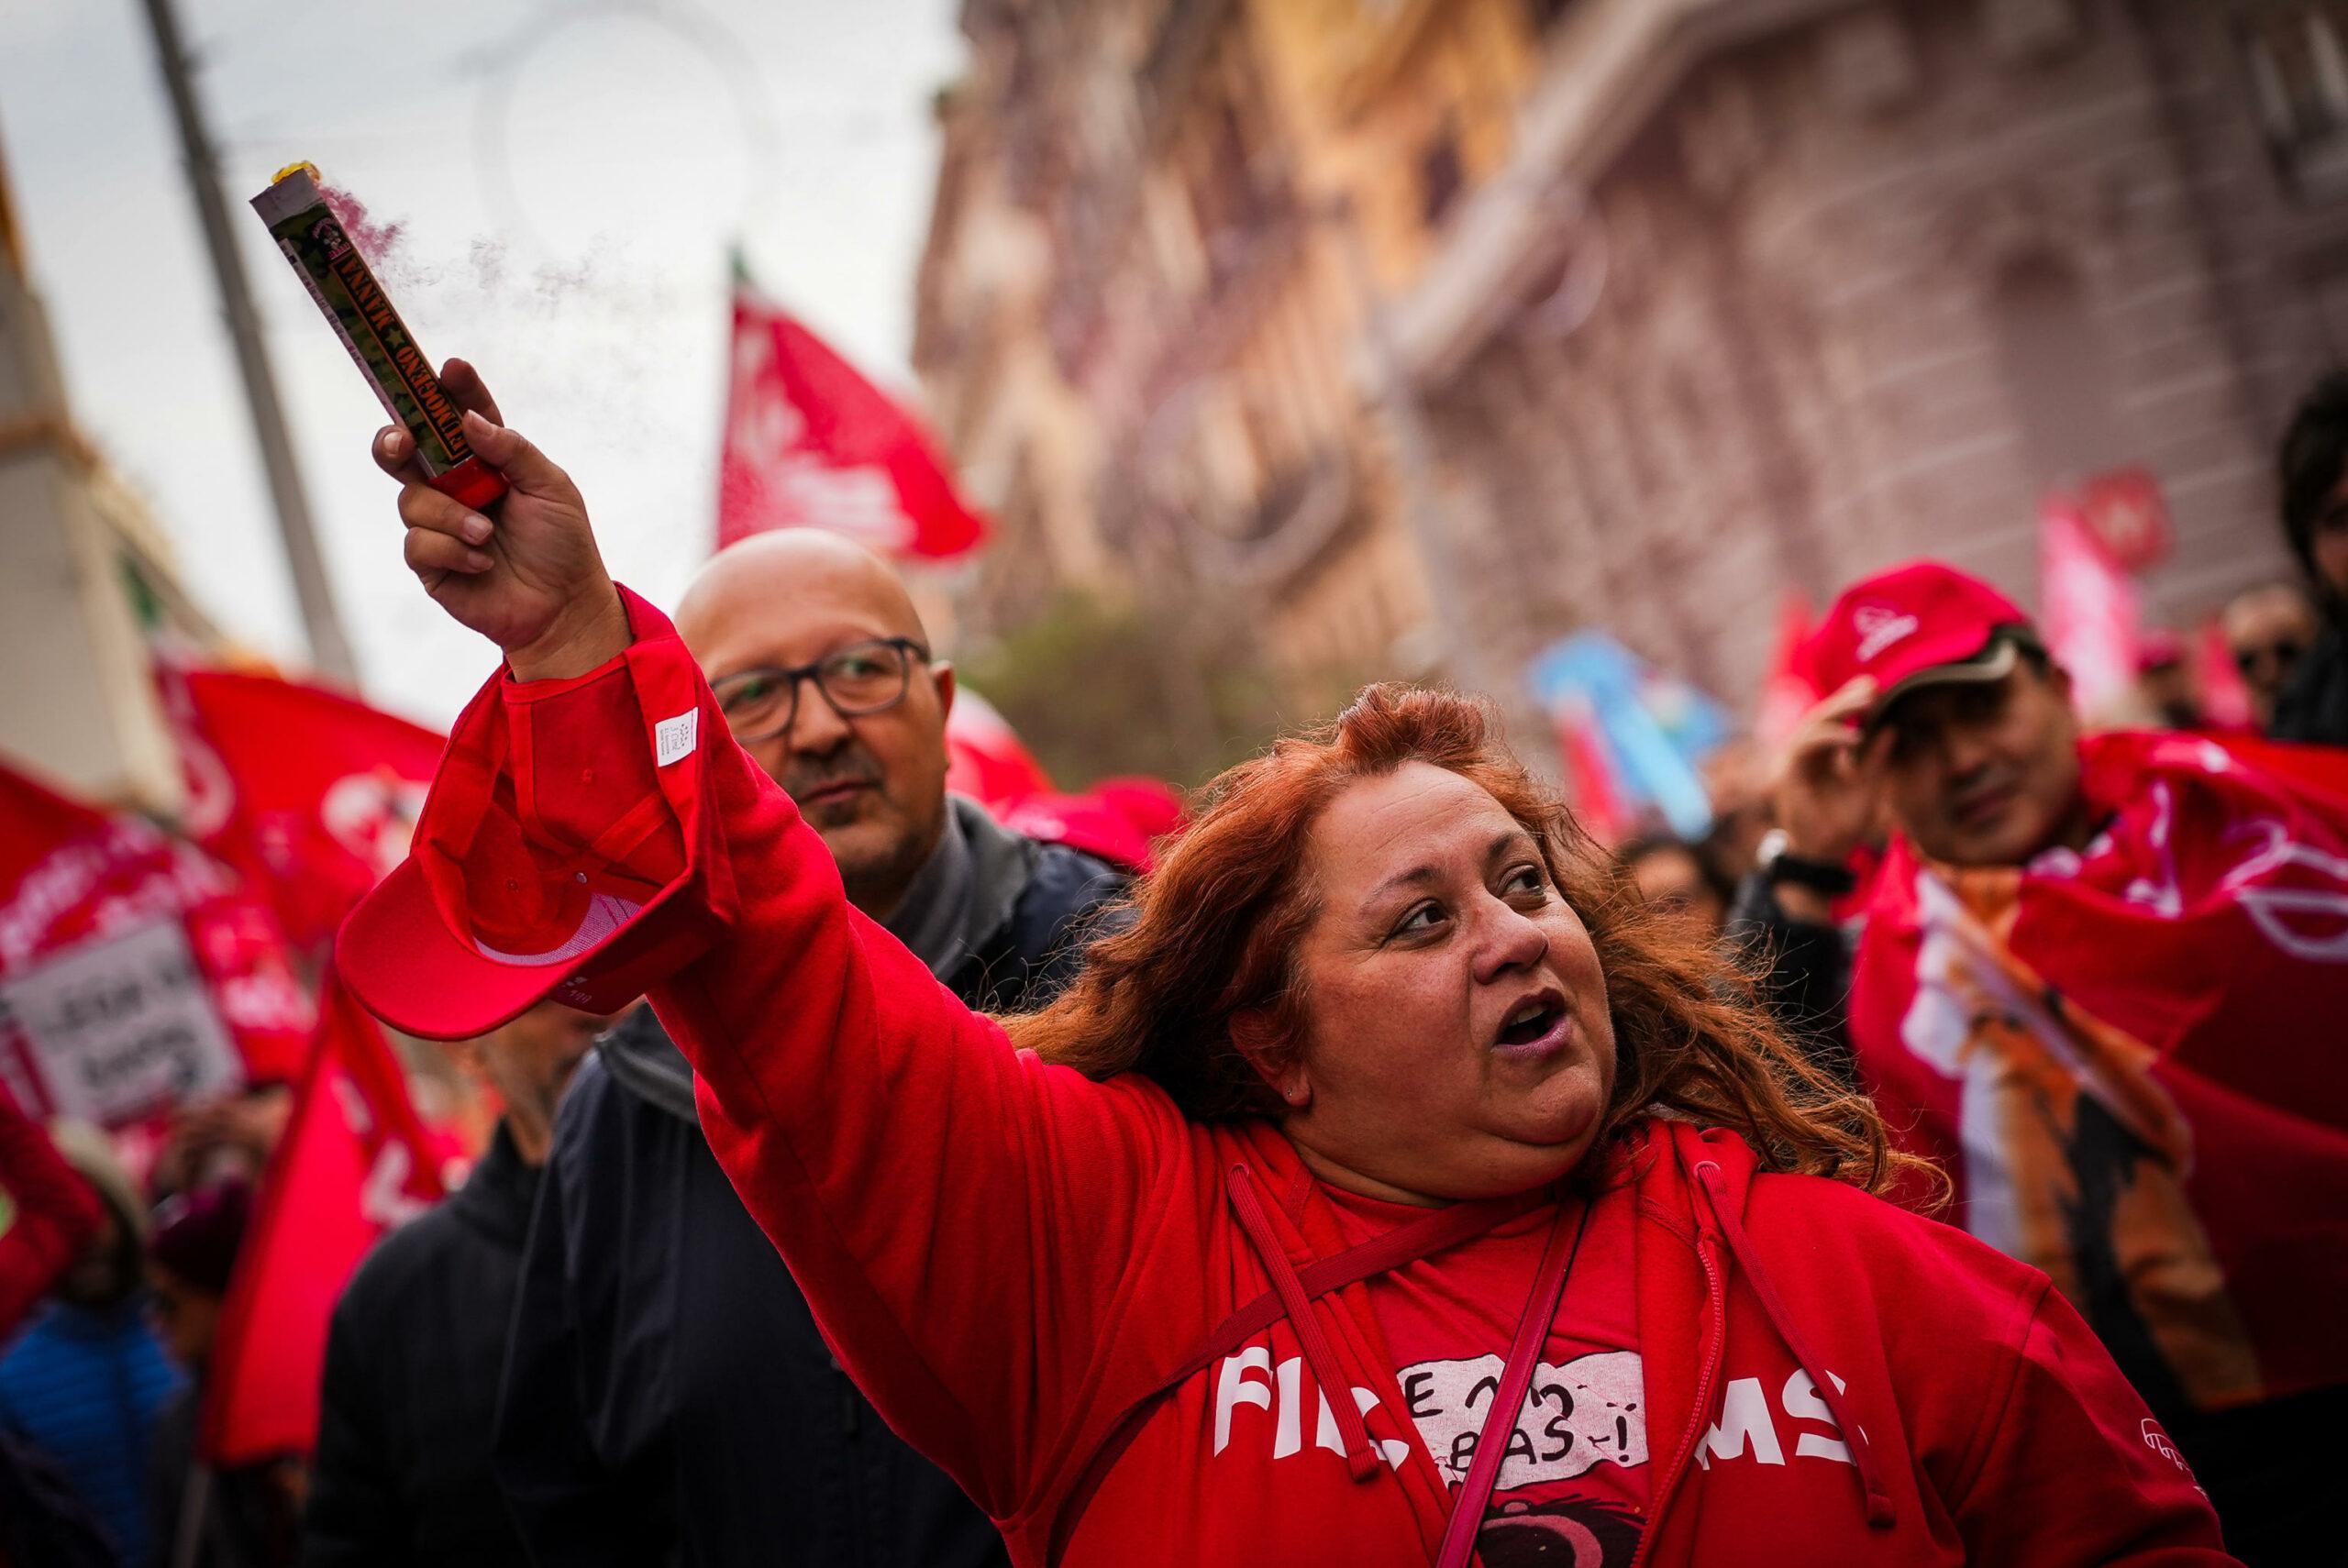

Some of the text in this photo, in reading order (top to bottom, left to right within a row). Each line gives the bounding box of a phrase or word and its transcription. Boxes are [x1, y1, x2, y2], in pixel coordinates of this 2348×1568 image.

[340, 258, 468, 452] FUMOGENO MANNA
[1404, 1372, 1443, 1418] E
